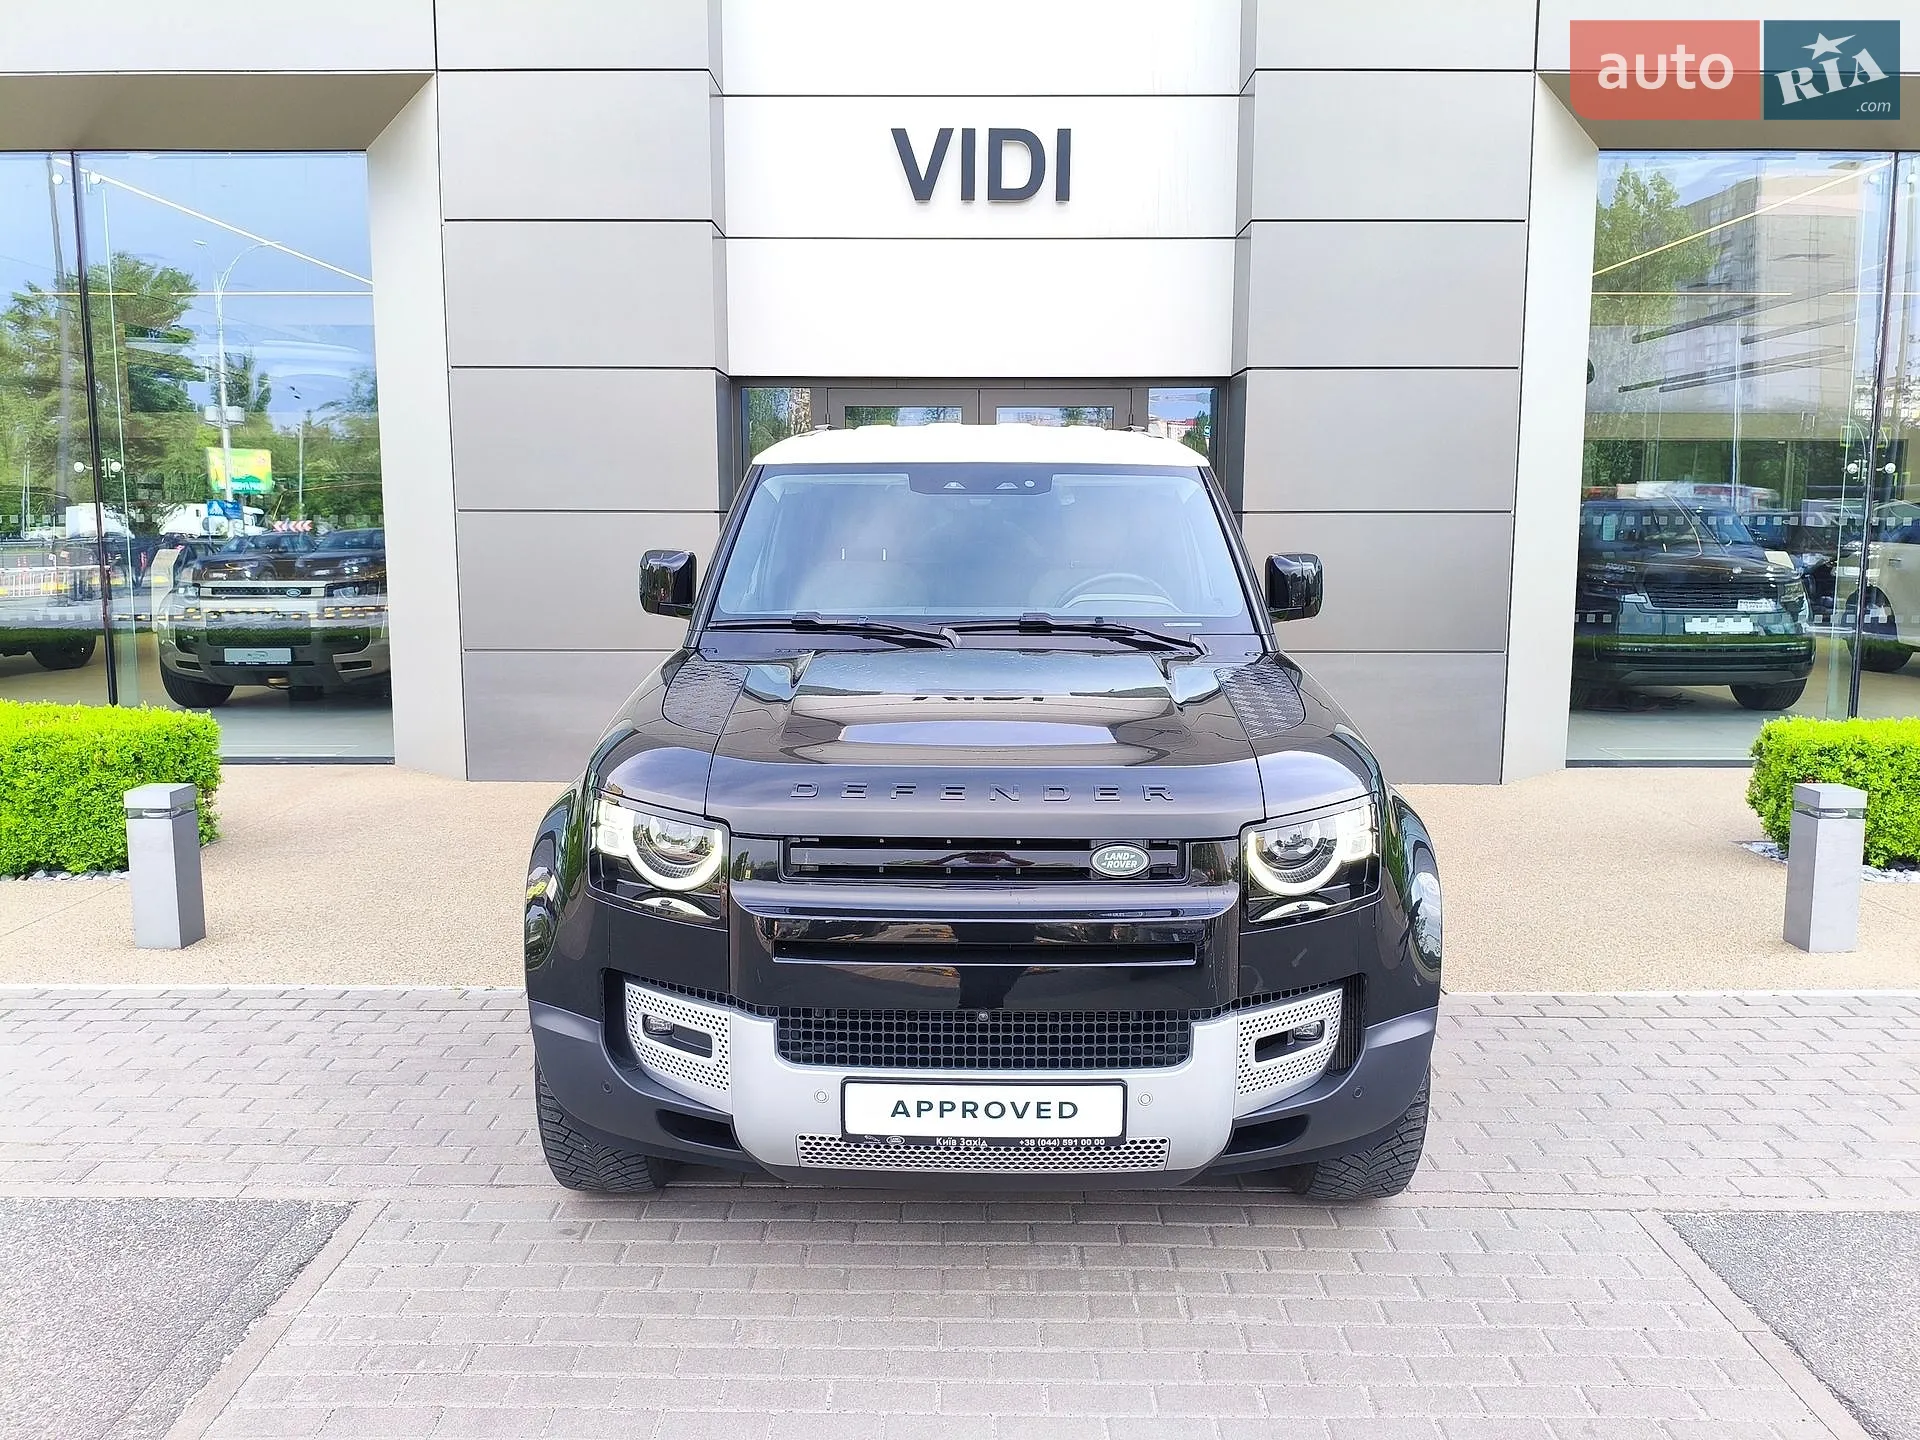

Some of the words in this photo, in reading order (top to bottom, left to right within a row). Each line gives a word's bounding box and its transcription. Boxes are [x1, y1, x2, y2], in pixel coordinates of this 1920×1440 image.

[890, 127, 1072, 202] VIDI
[790, 782, 1174, 802] DEFENDER
[1104, 852, 1130, 861] LAND
[1106, 860, 1138, 869] ROVER
[890, 1099, 1079, 1119] APPROVED
[936, 1137, 957, 1147] Київ
[960, 1137, 988, 1148] Захід
[1019, 1138, 1036, 1146] +38
[1037, 1138, 1060, 1147] (044)
[1062, 1138, 1078, 1146] 591
[1080, 1138, 1092, 1146] 00
[1094, 1138, 1106, 1146] 00
